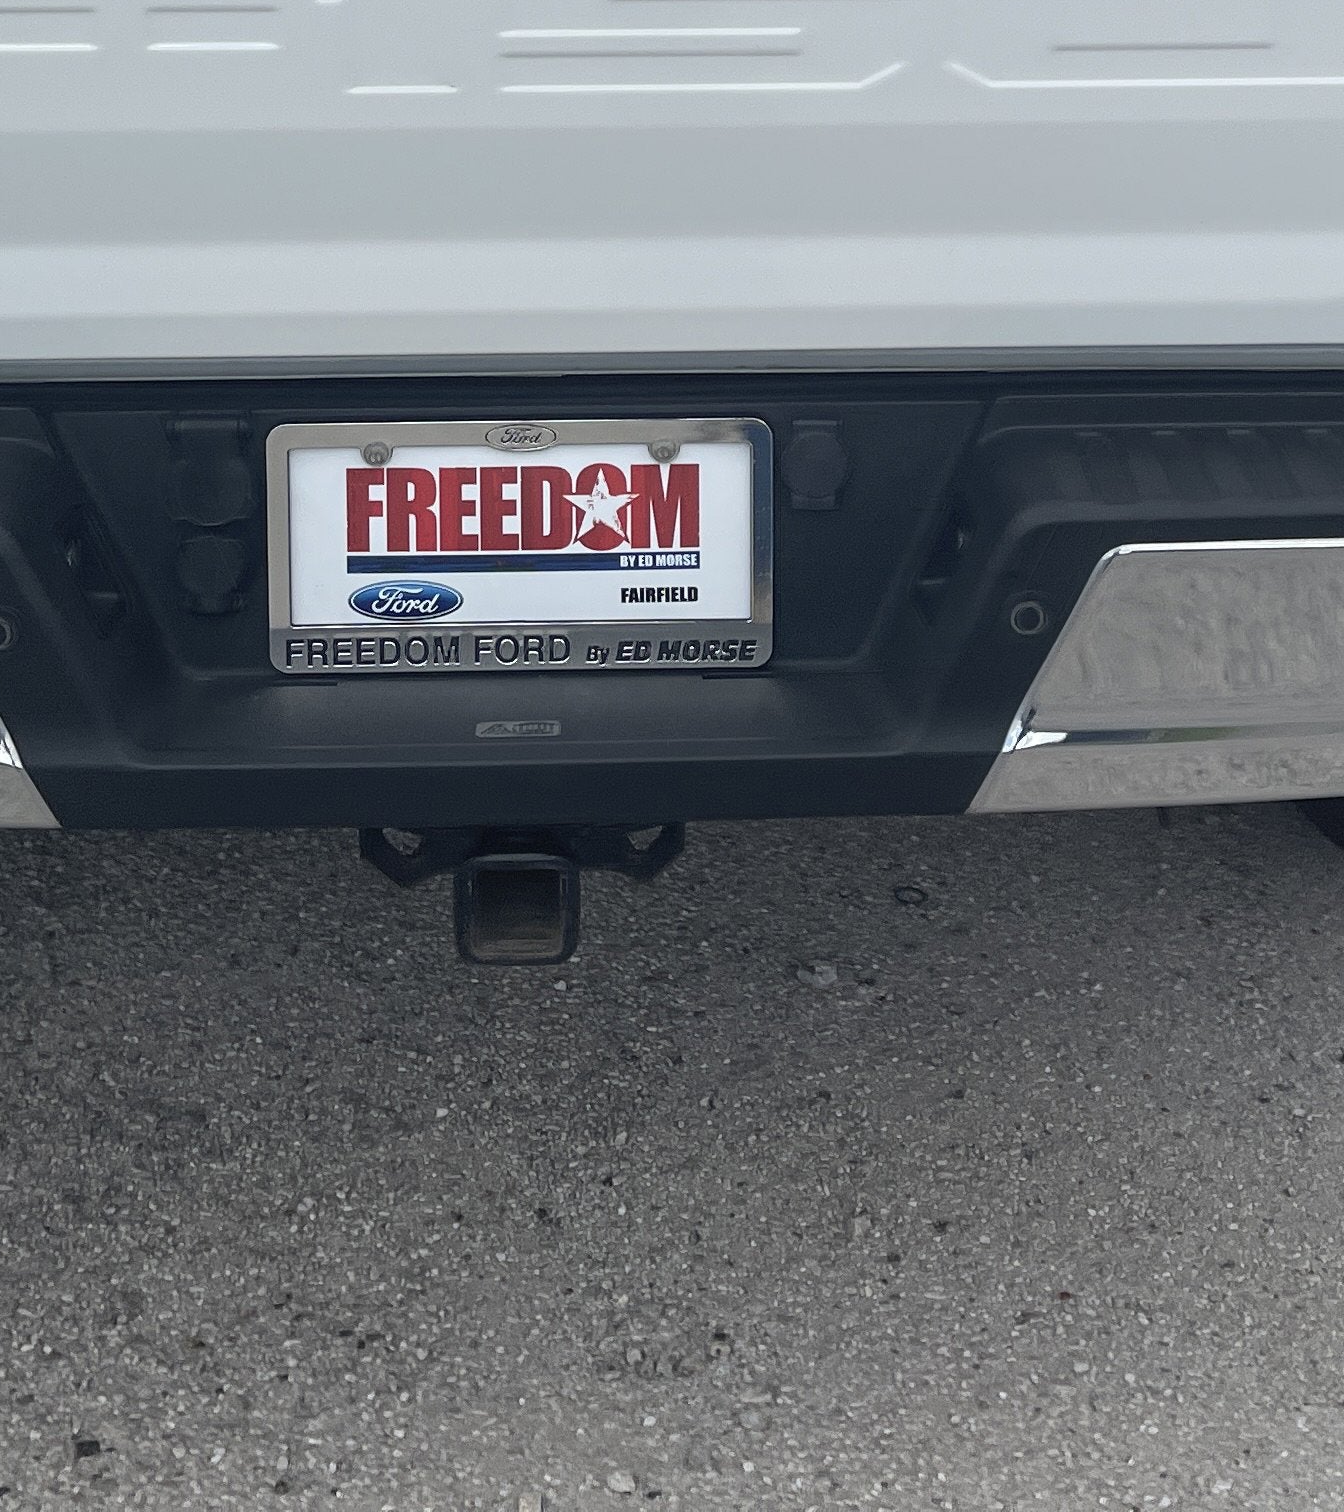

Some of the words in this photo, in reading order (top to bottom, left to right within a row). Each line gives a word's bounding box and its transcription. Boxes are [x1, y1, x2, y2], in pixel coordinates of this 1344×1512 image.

[500, 427, 543, 445] Ford
[346, 462, 700, 552] FREEDOM
[619, 555, 637, 567] BY
[638, 555, 653, 567] ED
[655, 553, 698, 567] MORSE
[371, 586, 439, 614] Ford
[621, 587, 699, 603] FAIRFIELD
[285, 636, 460, 668] FREEDOM
[474, 634, 571, 666] FORD
[585, 645, 610, 667] By
[615, 640, 652, 664] ED
[656, 639, 758, 663] MORSE
